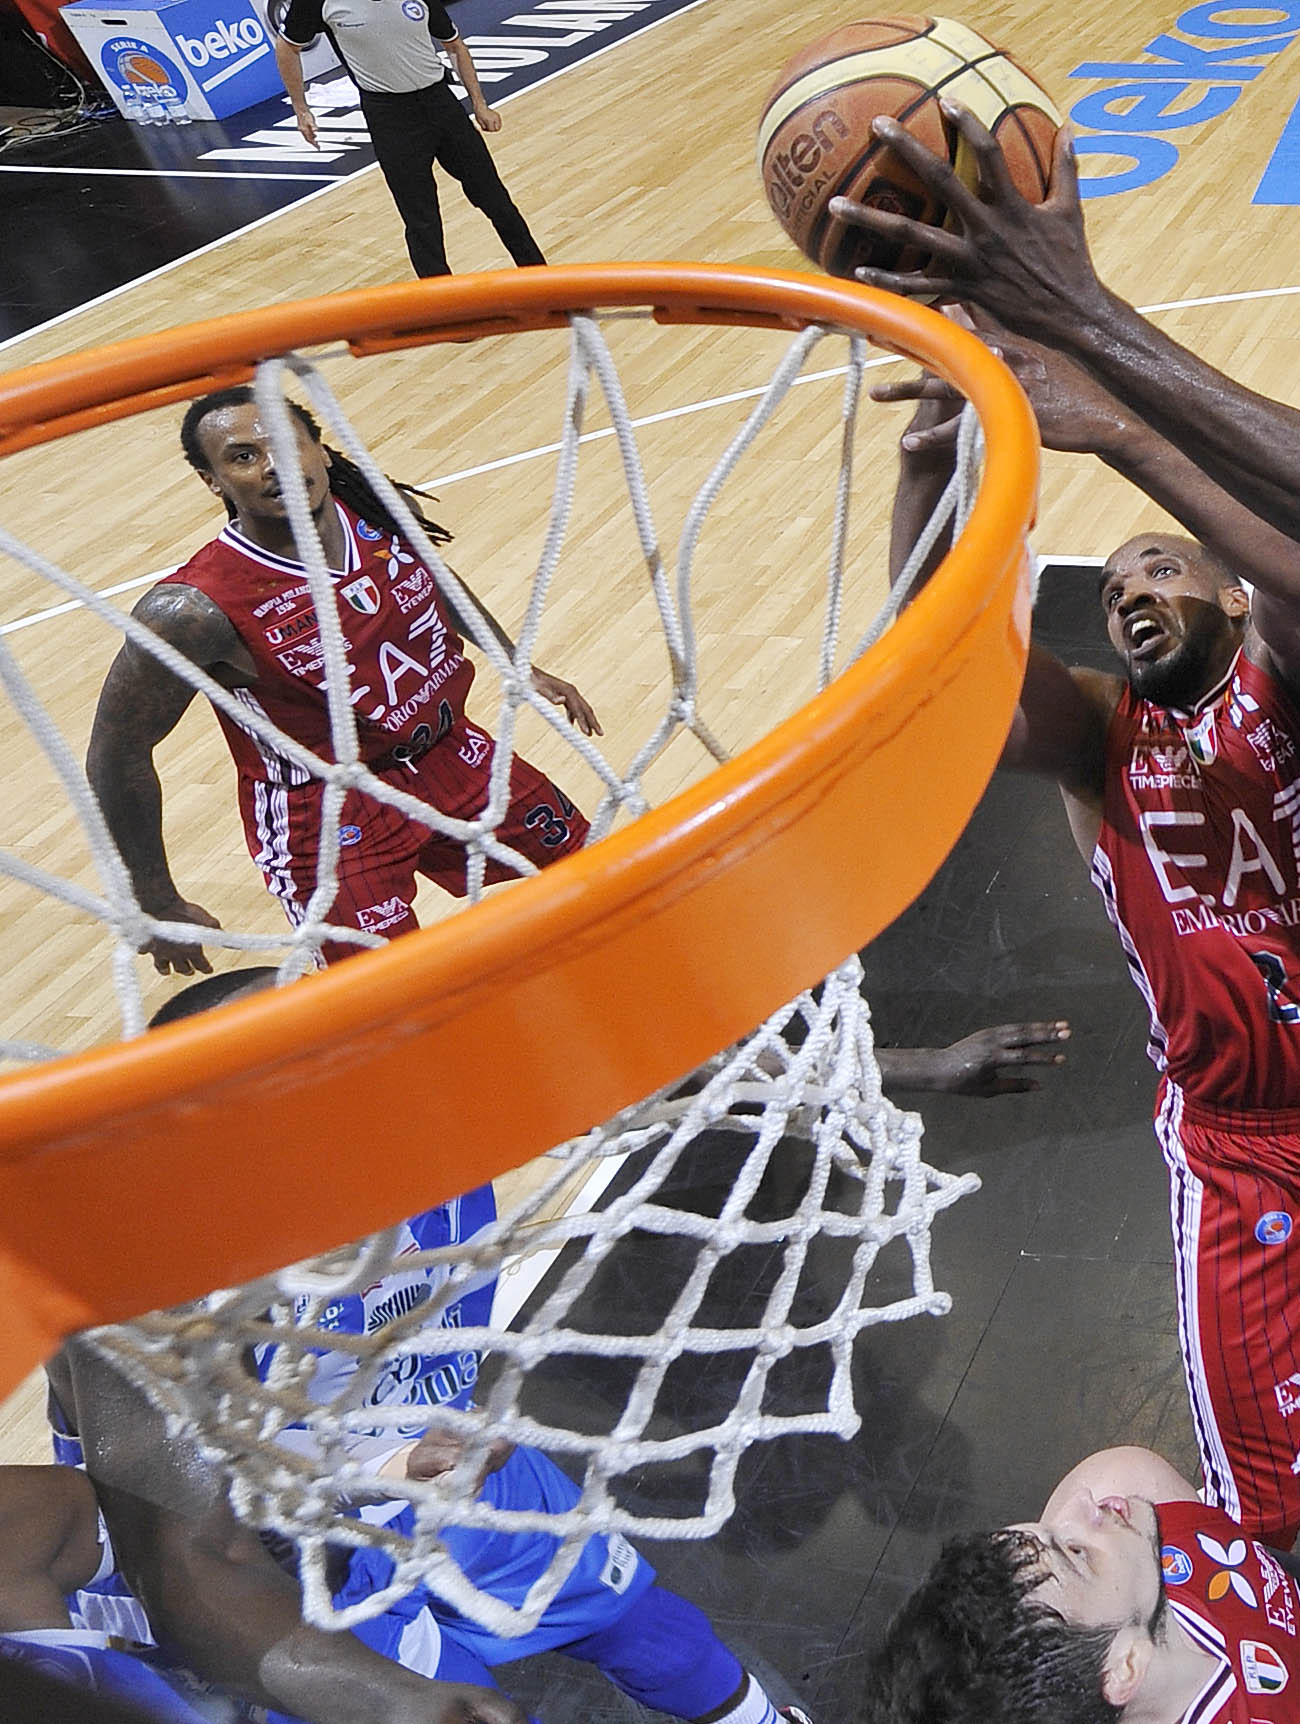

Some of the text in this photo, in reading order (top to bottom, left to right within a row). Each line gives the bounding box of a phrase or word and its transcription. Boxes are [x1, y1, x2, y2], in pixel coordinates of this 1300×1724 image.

[175, 18, 264, 67] beko
[769, 109, 850, 220] olten
[265, 612, 319, 645] UMAN
